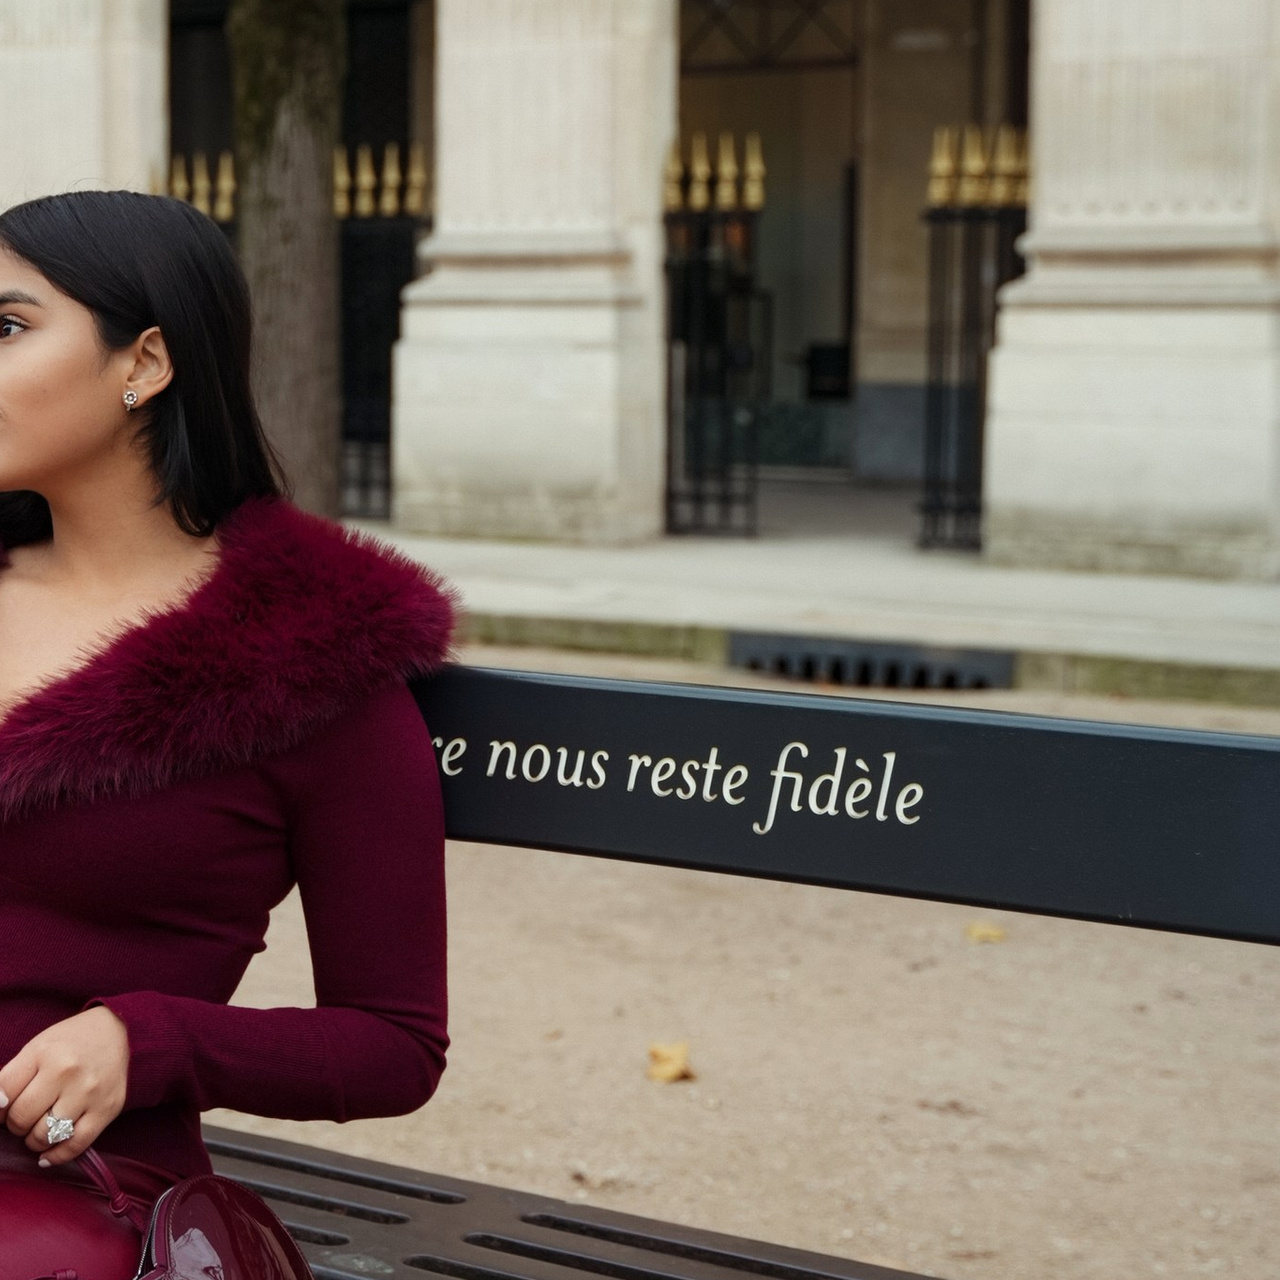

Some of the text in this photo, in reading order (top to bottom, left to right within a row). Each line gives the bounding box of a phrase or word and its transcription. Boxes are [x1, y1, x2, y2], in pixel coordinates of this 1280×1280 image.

[486, 740, 610, 790] nous
[627, 747, 749, 805] reste
[752, 741, 924, 836] fidèle
